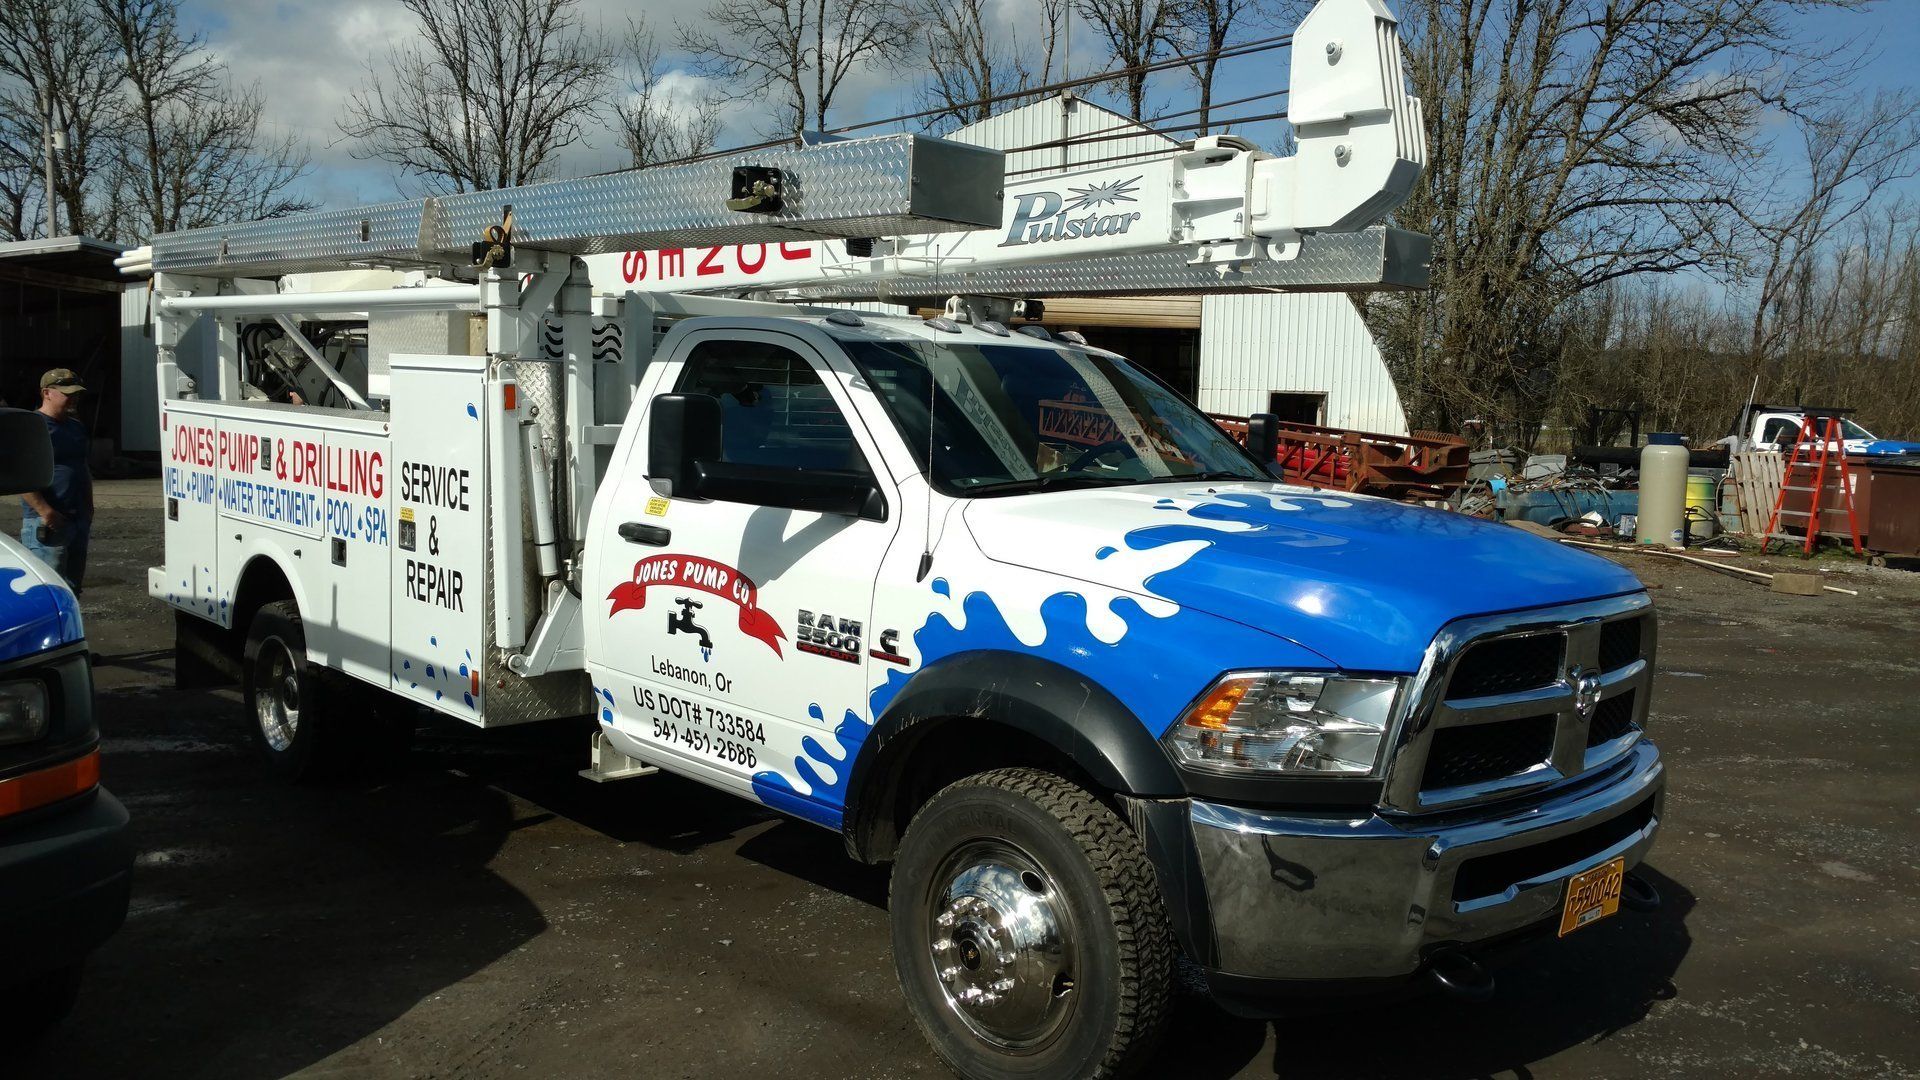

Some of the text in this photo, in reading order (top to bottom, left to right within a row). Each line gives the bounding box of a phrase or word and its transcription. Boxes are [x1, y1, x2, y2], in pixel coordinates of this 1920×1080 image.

[997, 191, 1141, 248] Pulstar
[171, 424, 383, 499] JONES PUMP & DRILLING
[401, 460, 470, 512] SERVICE
[165, 466, 388, 547] WELL PUMP WATER TREATMENT POOL SPA
[428, 515, 440, 556] &
[406, 558, 464, 613] REPAIR
[635, 559, 753, 610] JONES PUMP CO.
[797, 625, 861, 653] 5500
[798, 608, 863, 637] RAM
[651, 654, 733, 695] Lebanon, Or
[633, 685, 767, 746] US DOT# 733584
[653, 717, 758, 769] 541-451-2686
